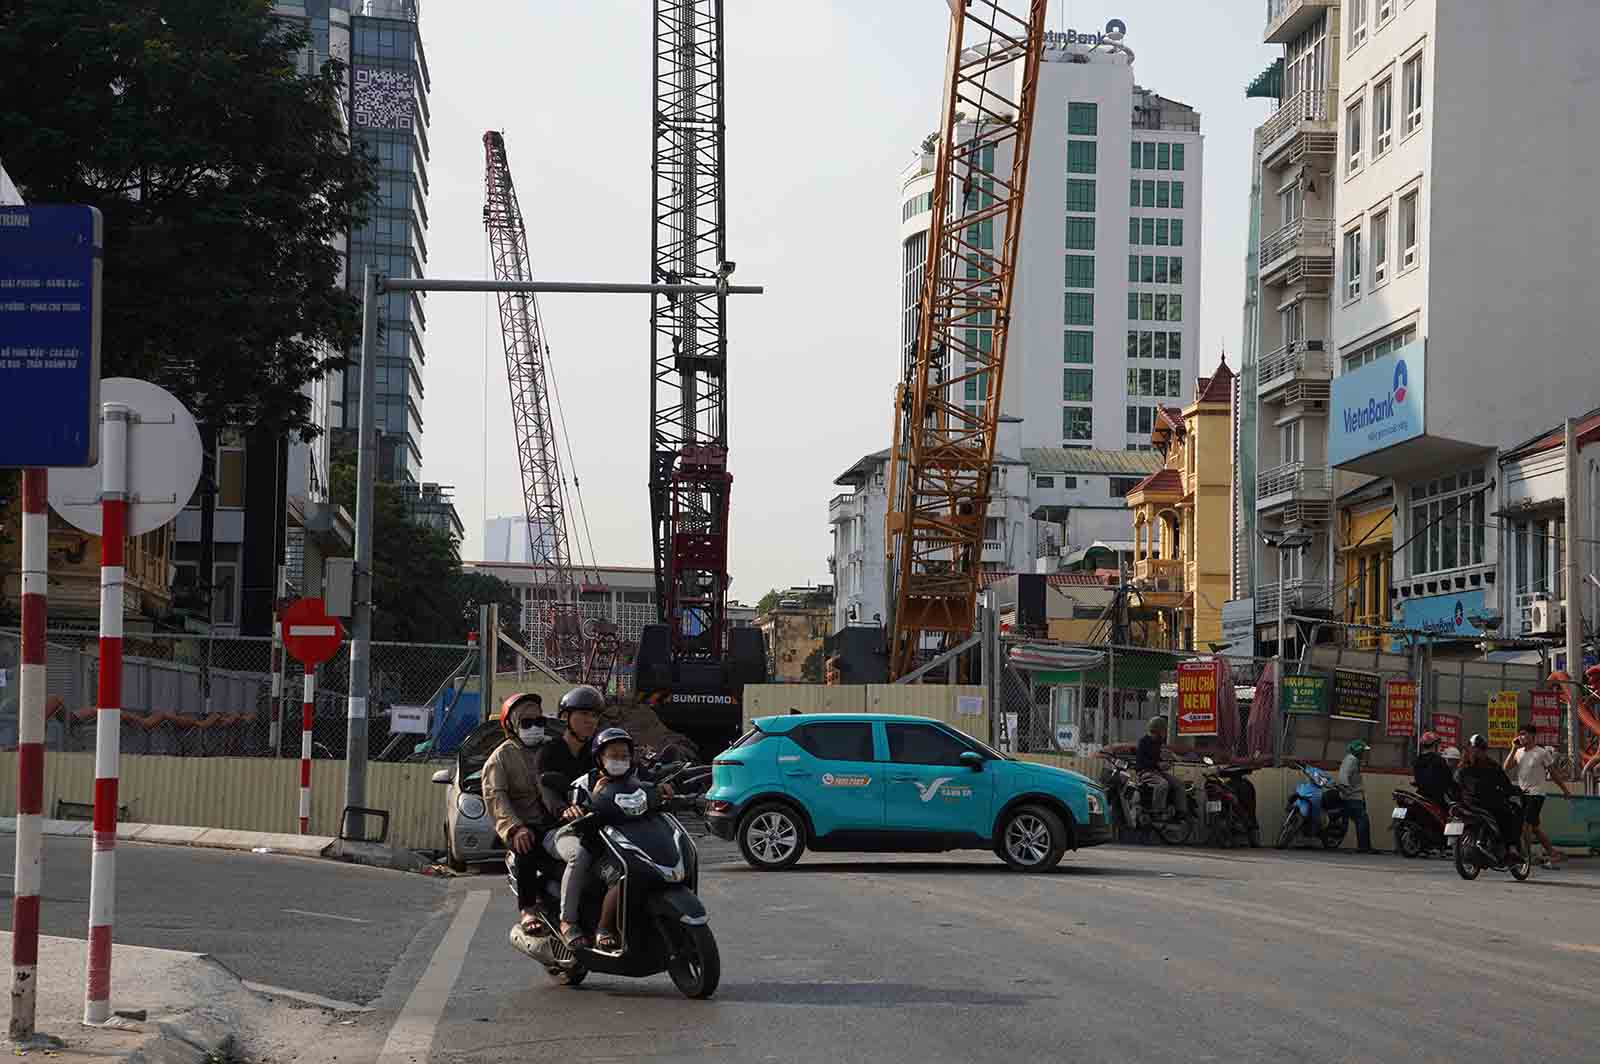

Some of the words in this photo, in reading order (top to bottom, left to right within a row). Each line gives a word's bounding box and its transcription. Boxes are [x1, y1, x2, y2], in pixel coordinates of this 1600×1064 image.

[1043, 29, 1104, 44] etinBank
[1344, 391, 1394, 433] VietinBank
[672, 694, 732, 705] SUMITOMO
